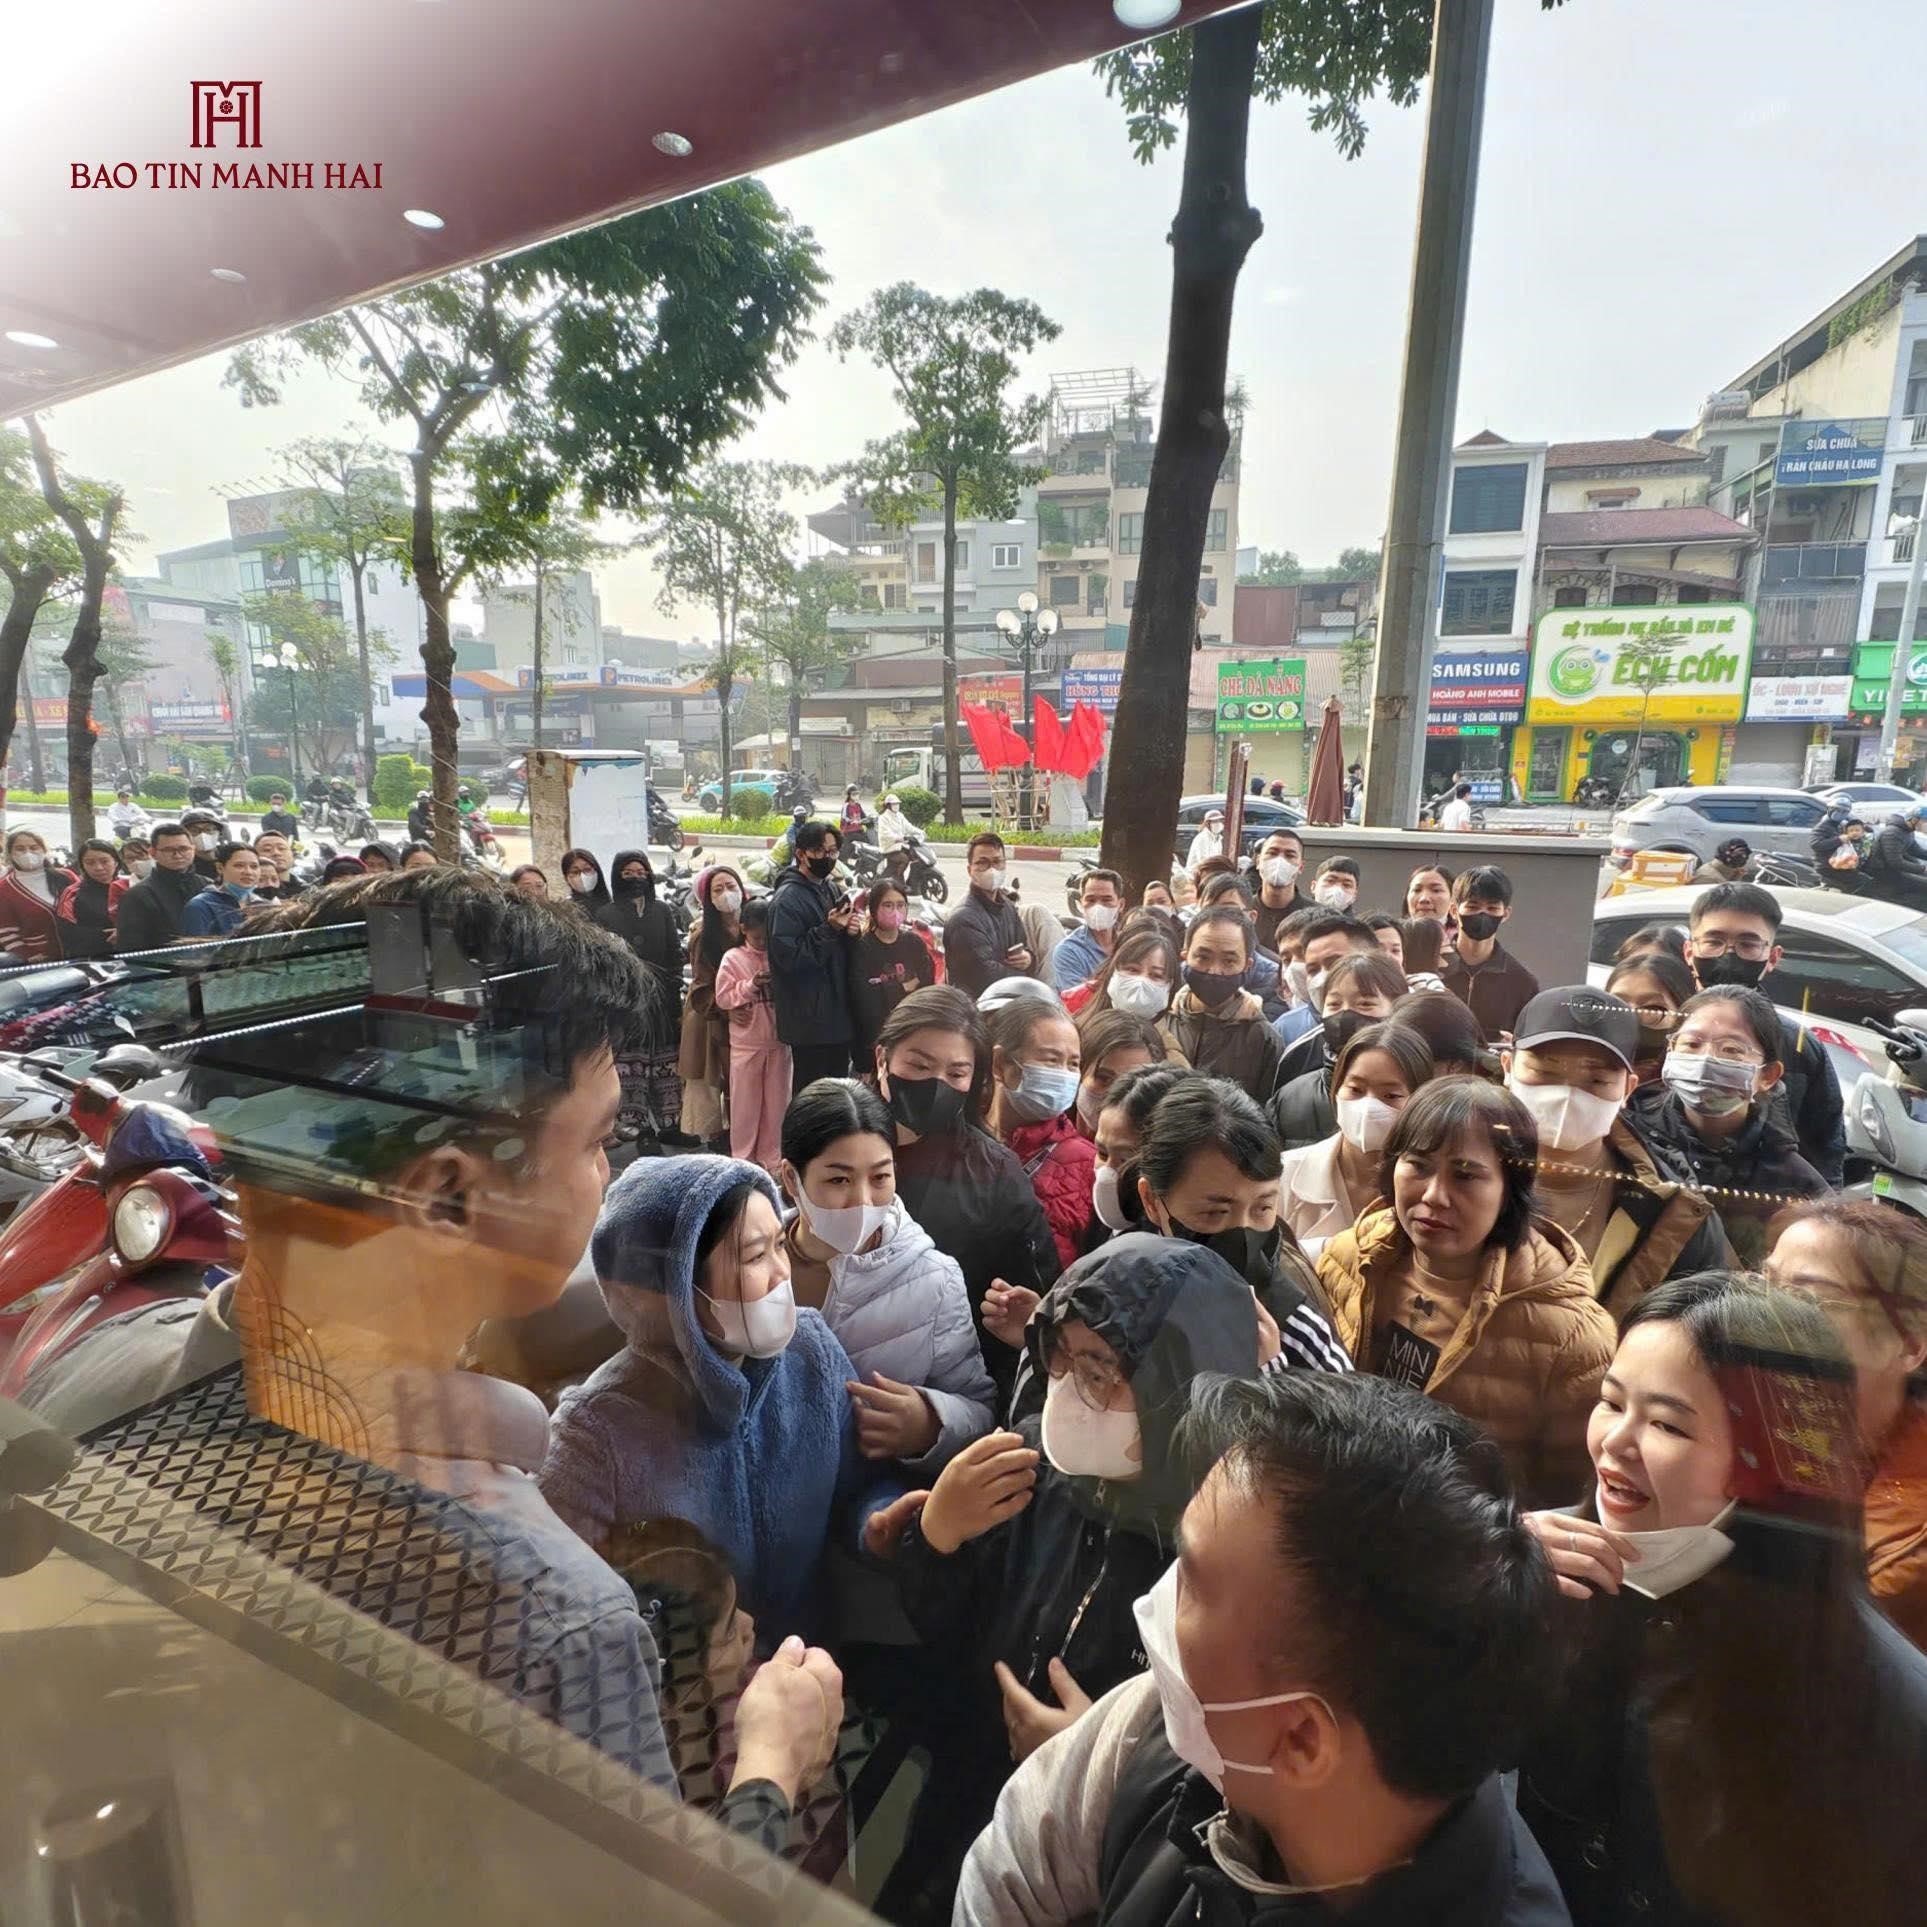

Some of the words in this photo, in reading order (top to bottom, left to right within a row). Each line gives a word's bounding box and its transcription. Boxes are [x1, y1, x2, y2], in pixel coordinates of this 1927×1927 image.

[1851, 458, 1877, 469] LONG
[1431, 662, 1521, 678] SAMSUNG
[1677, 643, 1740, 684] CỐM
[1432, 687, 1466, 699] HOÀNG
[1466, 689, 1487, 699] ANH
[1487, 688, 1521, 698] MOBILE
